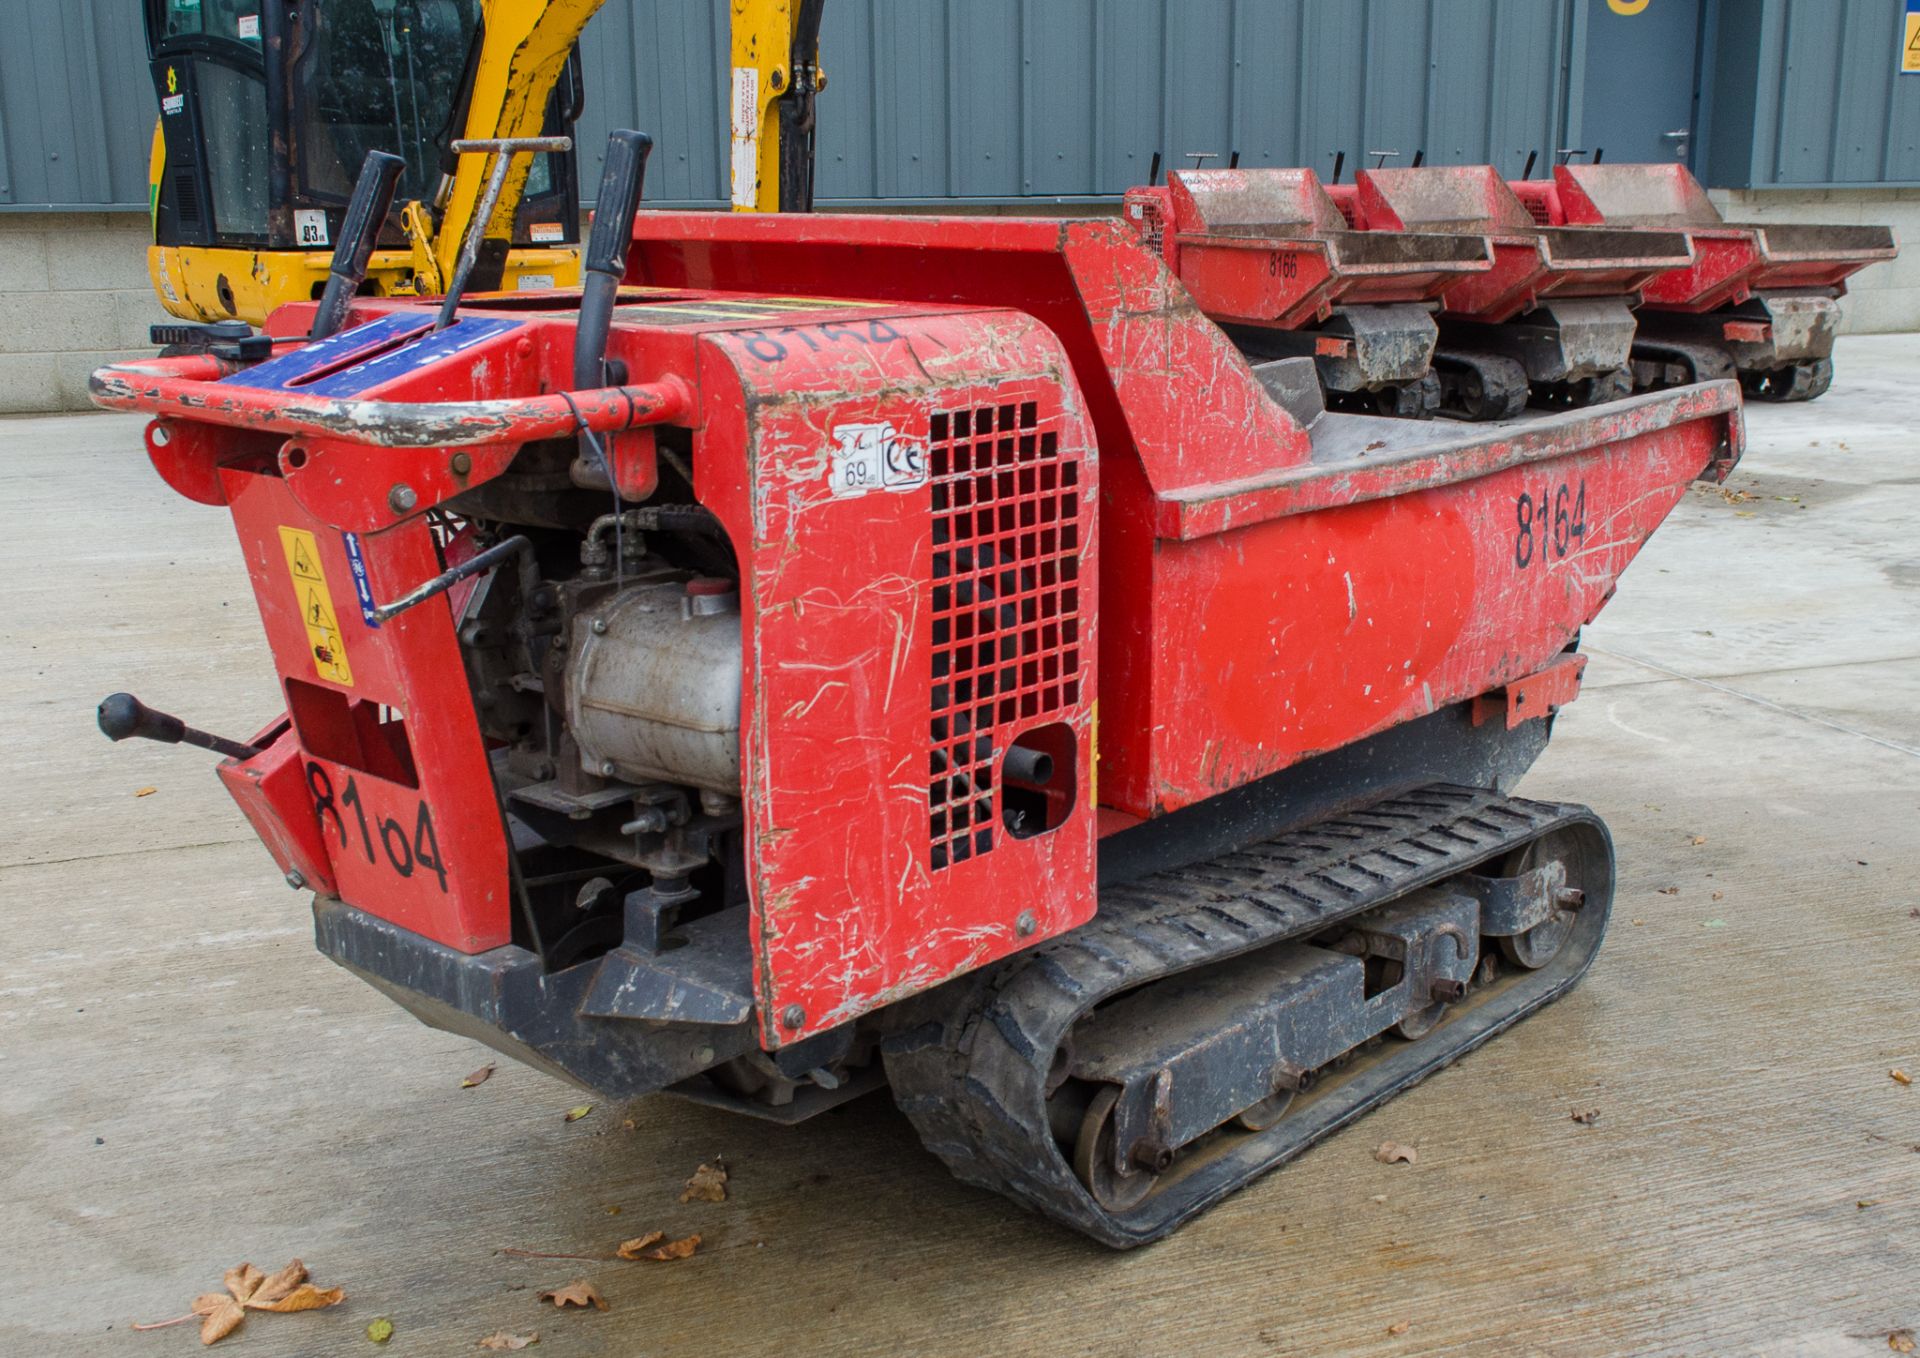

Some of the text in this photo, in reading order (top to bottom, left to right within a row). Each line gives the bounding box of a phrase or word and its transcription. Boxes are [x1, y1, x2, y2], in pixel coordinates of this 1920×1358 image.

[1269, 251, 1298, 279] 8166
[846, 461, 867, 487] 69
[1516, 479, 1586, 569] 8164
